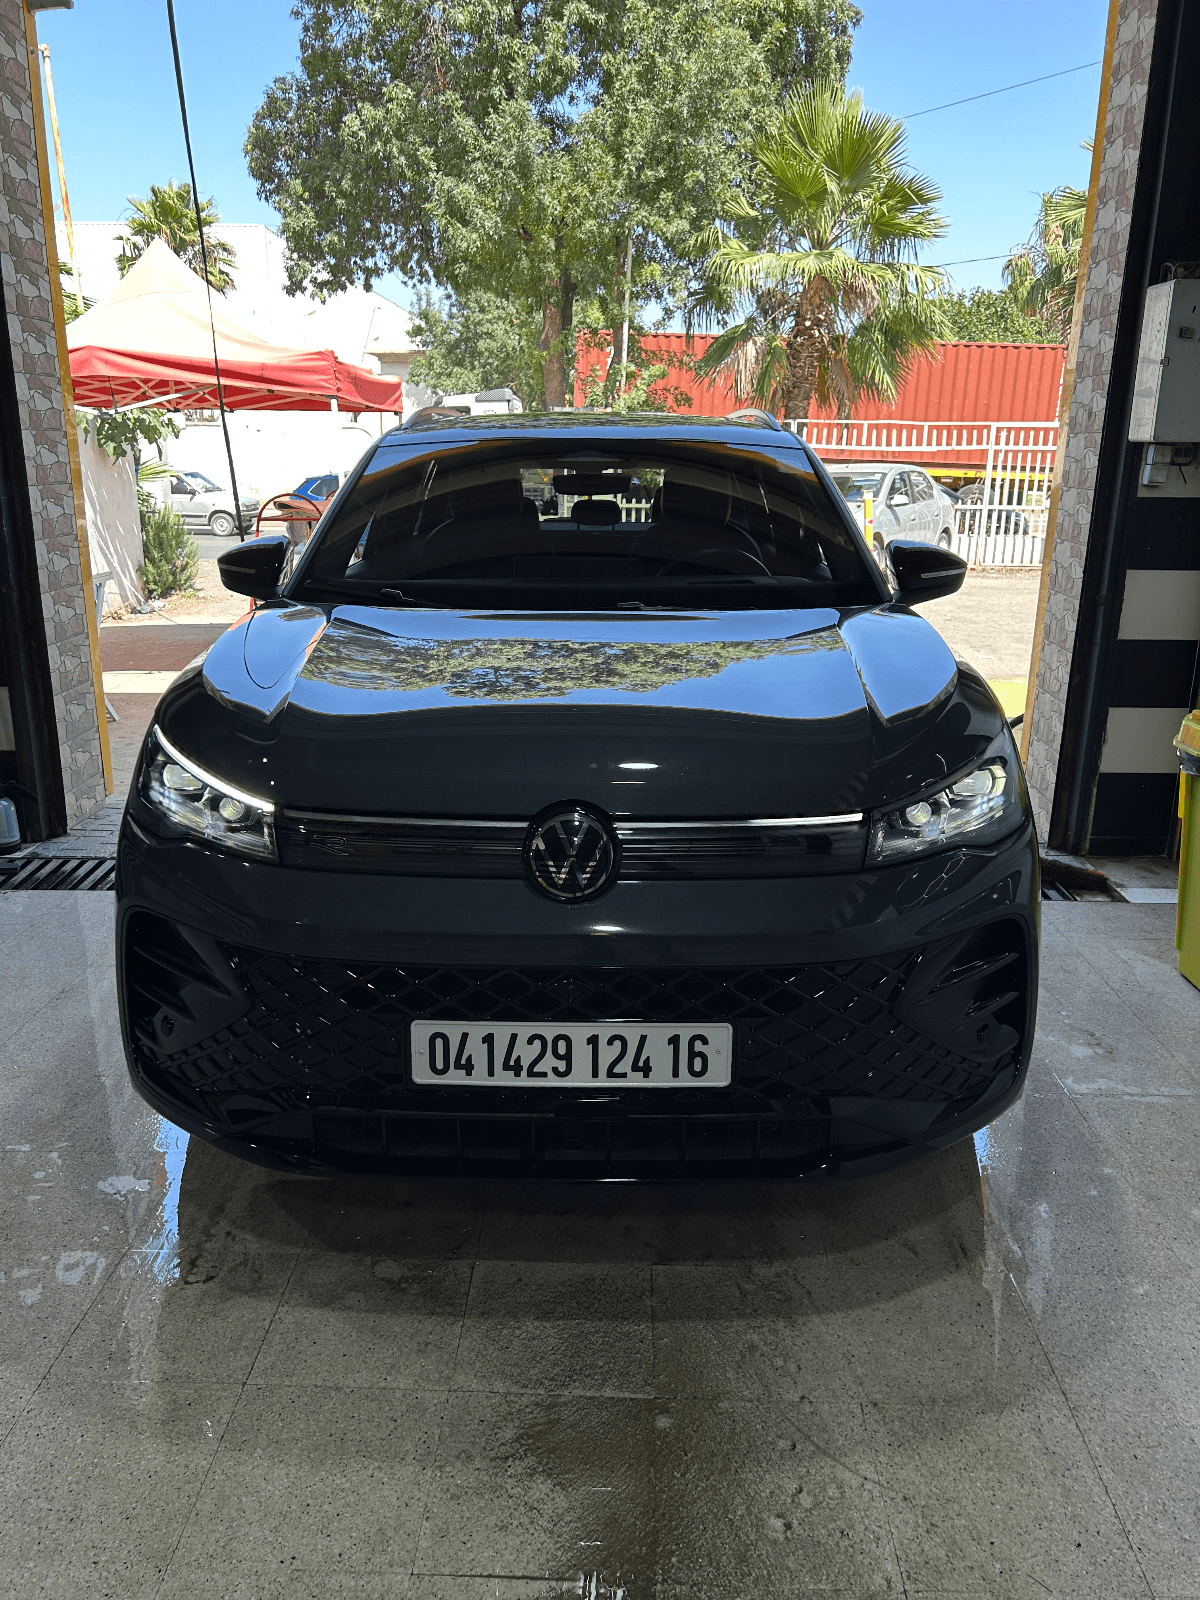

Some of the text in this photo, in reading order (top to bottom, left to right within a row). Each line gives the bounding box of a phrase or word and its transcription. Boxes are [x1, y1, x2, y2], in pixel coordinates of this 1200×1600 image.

[530, 813, 614, 897] VW
[428, 1031, 710, 1079] 041429 124 16
